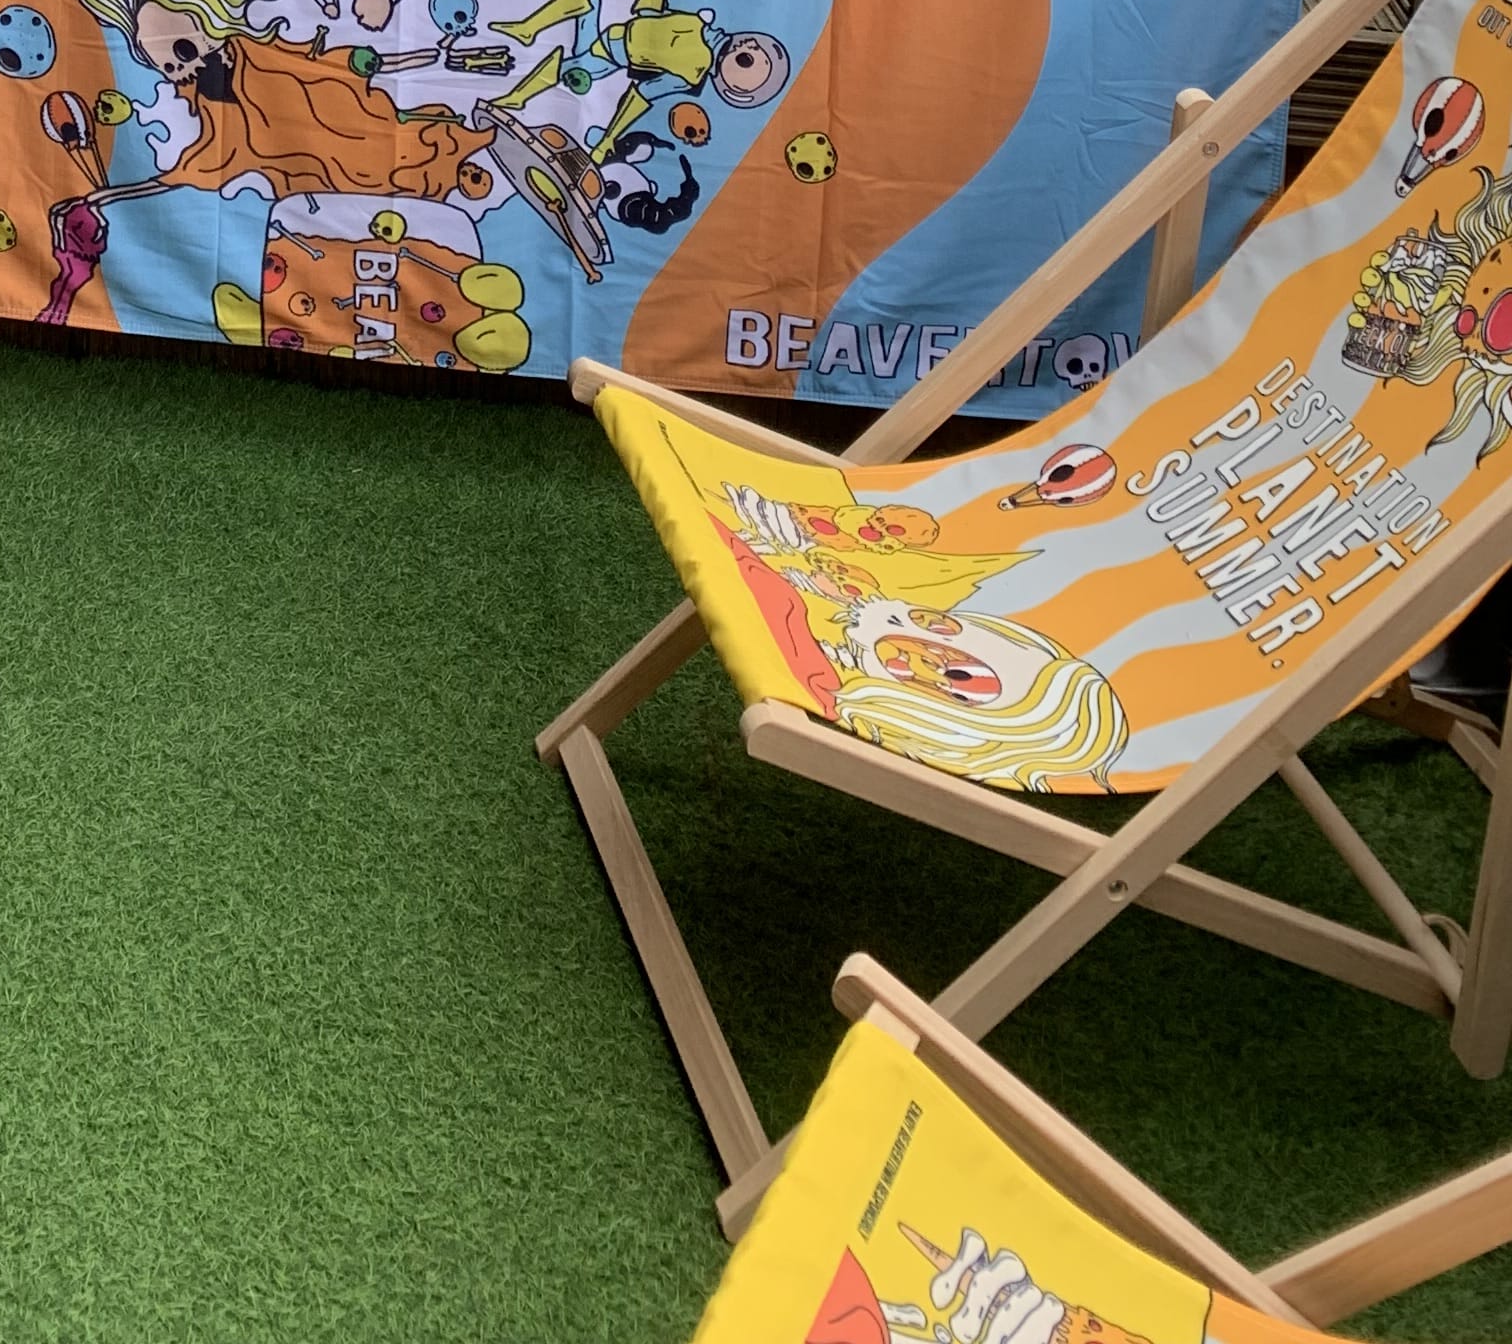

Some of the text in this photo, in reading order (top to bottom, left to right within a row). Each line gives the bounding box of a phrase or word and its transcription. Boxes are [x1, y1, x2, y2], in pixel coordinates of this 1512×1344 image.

[1477, 5, 1510, 39] OUT
[725, 309, 1142, 392] BEAVETO
[1190, 395, 1407, 605] PLANET
[1255, 357, 1451, 555] DESTINATION
[1126, 449, 1325, 669] SUMMER.
